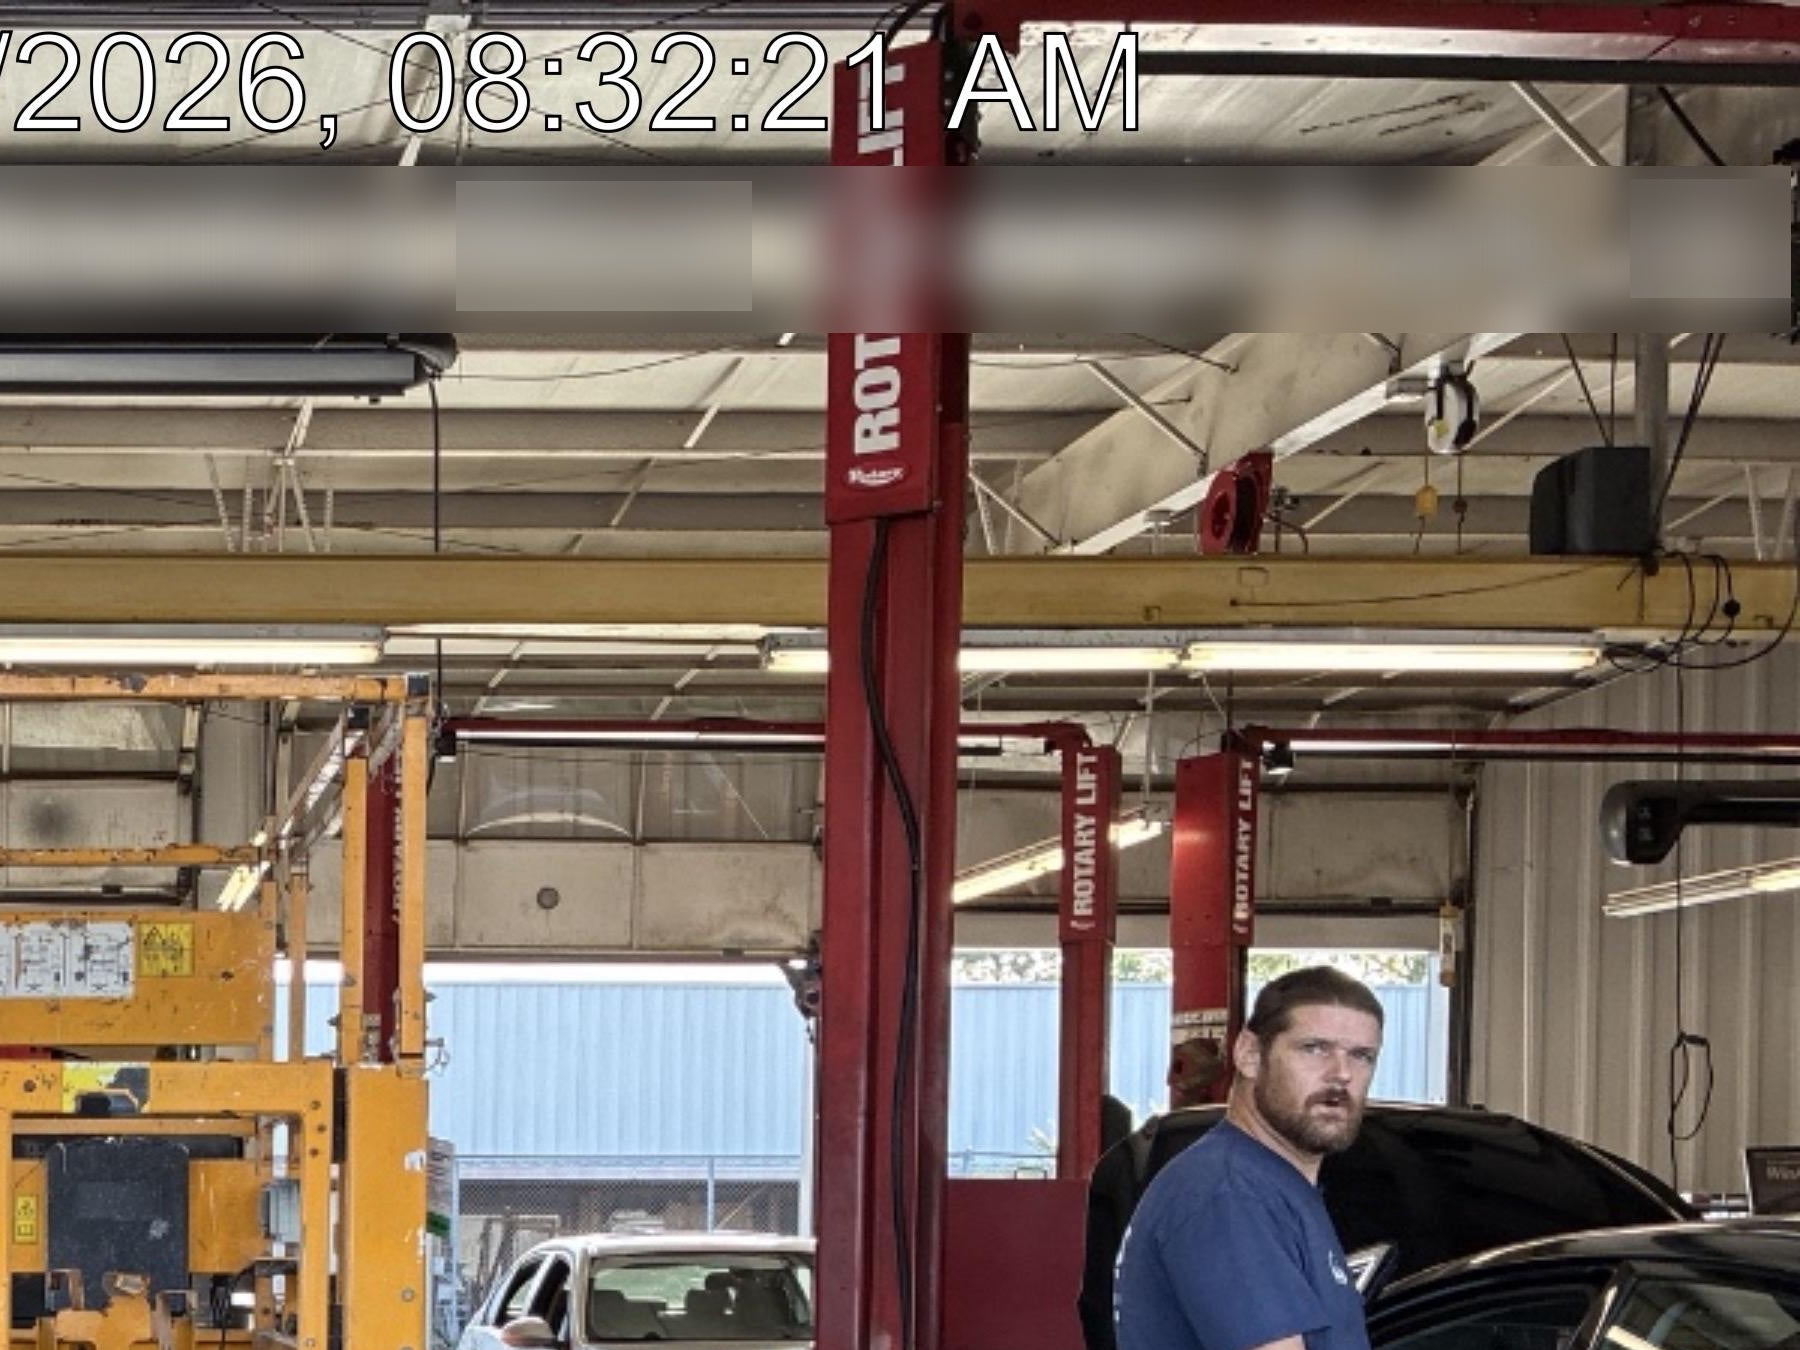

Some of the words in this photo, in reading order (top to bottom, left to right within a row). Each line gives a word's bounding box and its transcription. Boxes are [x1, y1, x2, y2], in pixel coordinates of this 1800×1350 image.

[854, 333, 901, 455] ROT
[1075, 751, 1098, 806] LIFT
[1237, 758, 1255, 811] LIFT
[1073, 812, 1097, 917] ROTARY
[1233, 816, 1252, 920] ROTARY
